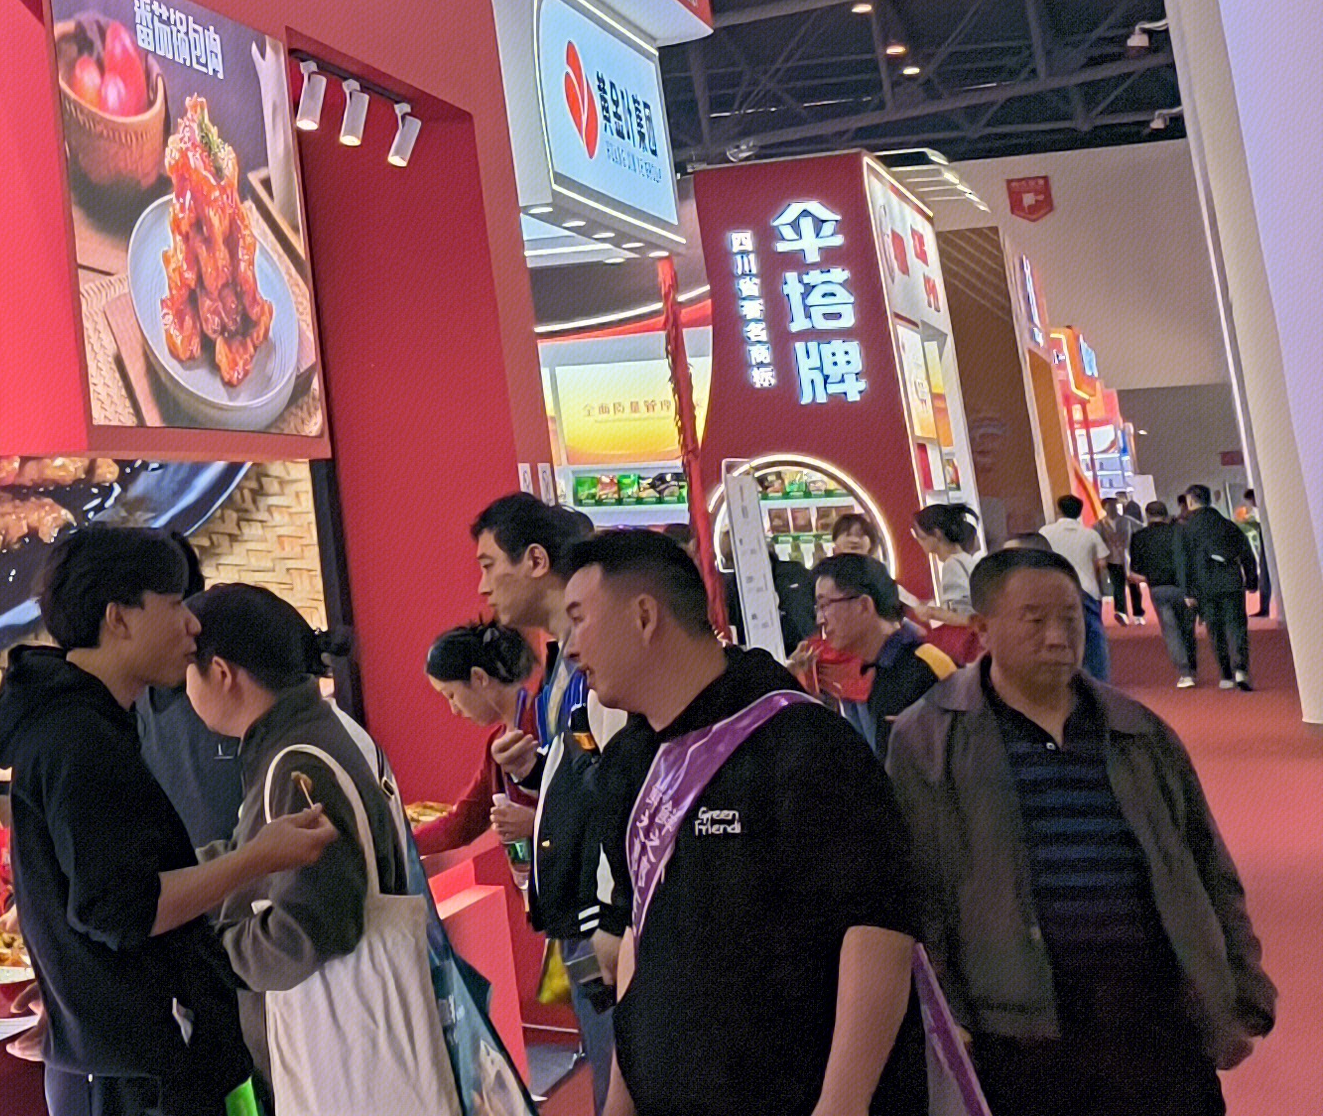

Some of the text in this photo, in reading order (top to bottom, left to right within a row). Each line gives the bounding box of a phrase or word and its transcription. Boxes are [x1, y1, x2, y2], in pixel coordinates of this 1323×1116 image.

[729, 231, 777, 389] 四川省著名商标
[770, 200, 867, 405] 伞塔牌
[698, 806, 740, 824] Green
